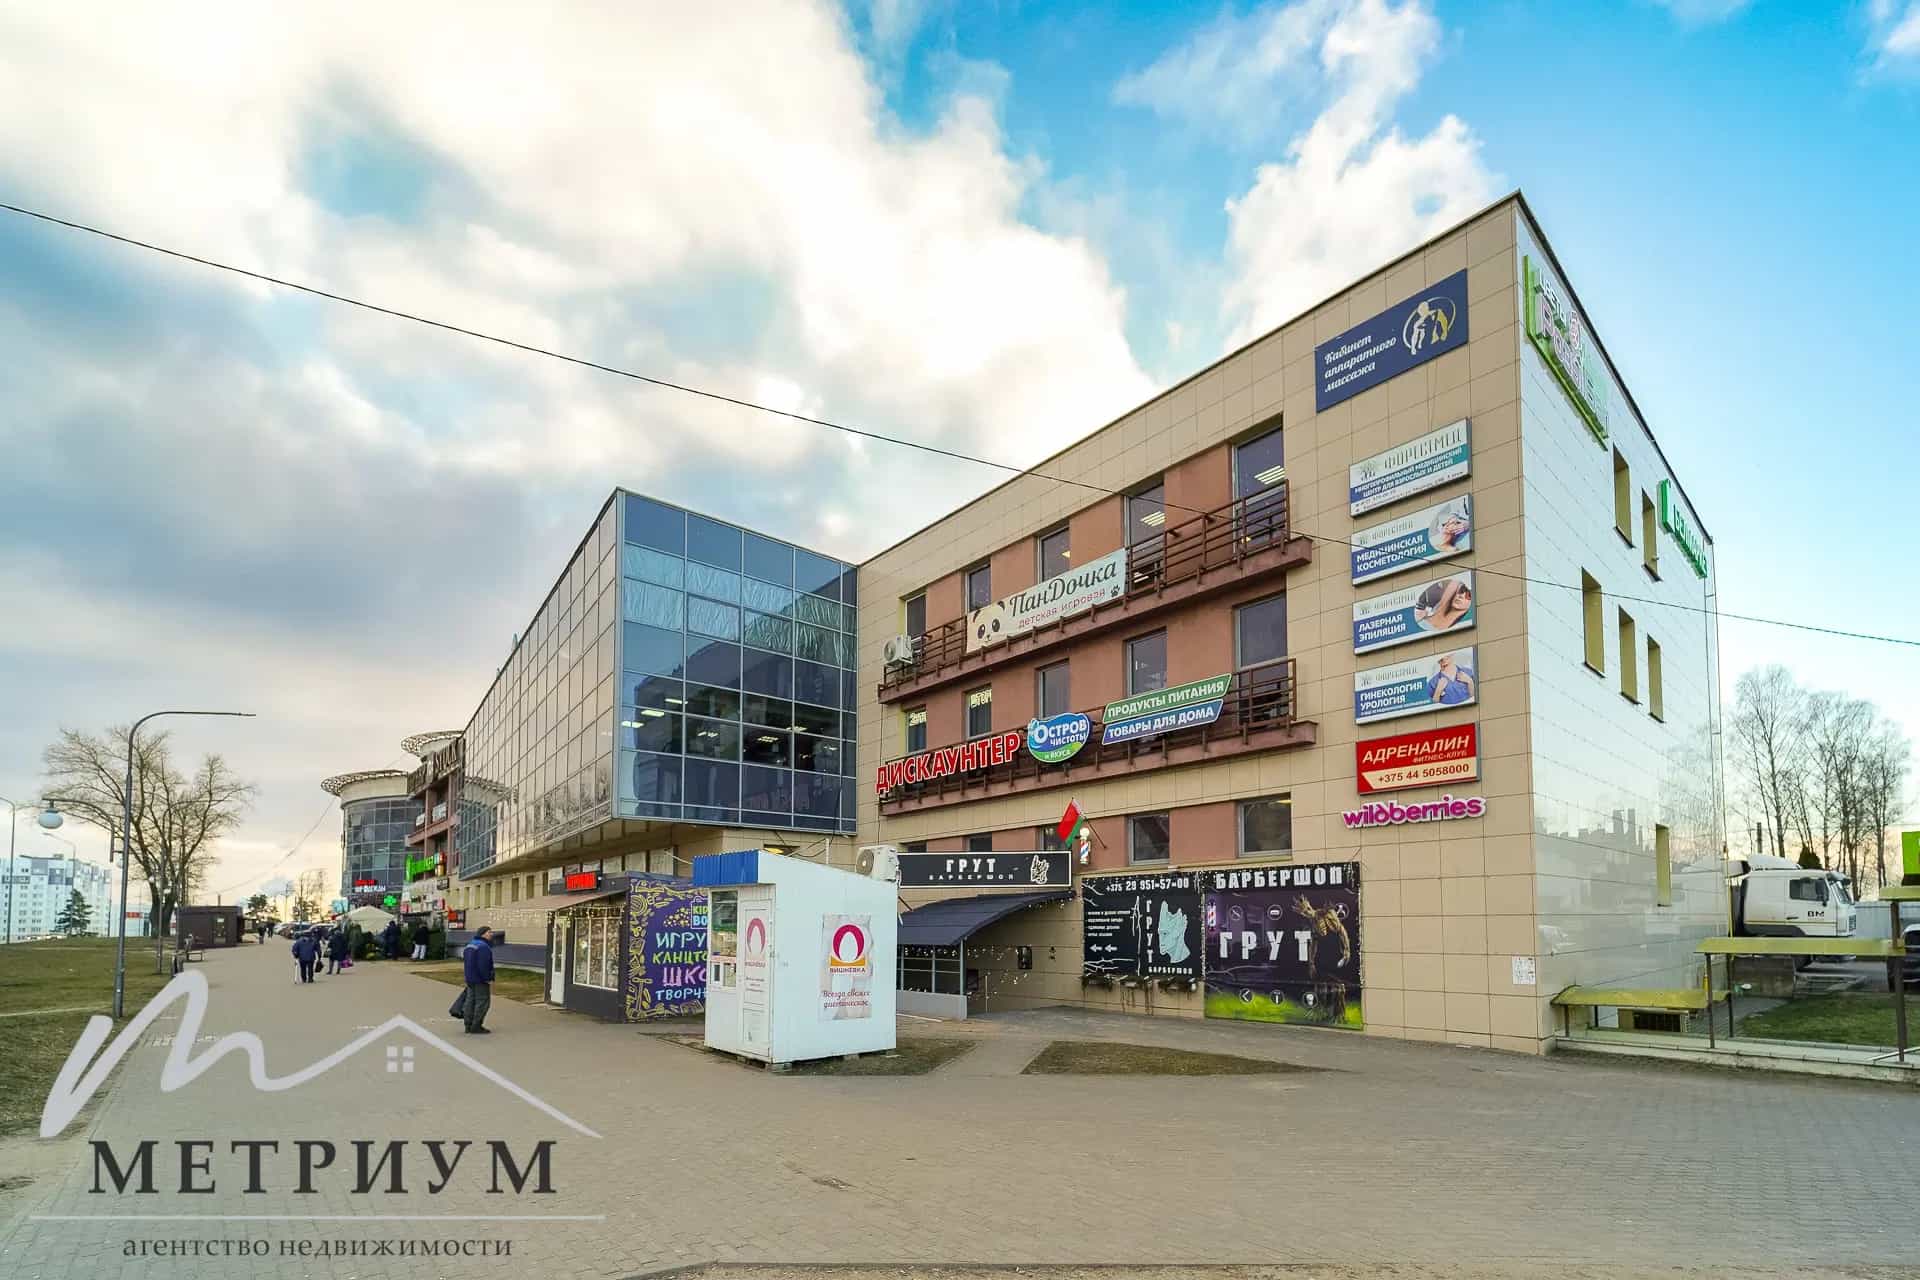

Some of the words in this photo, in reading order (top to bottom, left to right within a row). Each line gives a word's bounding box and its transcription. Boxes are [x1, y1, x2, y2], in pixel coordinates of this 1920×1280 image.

[1324, 336, 1372, 364] Кабинет
[1324, 337, 1397, 379] аппаратного
[1324, 361, 1376, 392] массажа
[1382, 482, 1395, 493] ДЛЯ
[1395, 470, 1427, 488] ВЗРОСЛЫХ
[1432, 459, 1454, 473] ДЕТЕЙ
[1356, 534, 1423, 563] МЕДИЦИНСКАЯ
[1357, 543, 1427, 572] КОСМЕТОЛОГИЯ
[1358, 613, 1403, 633] ЛАЗЕРНАЯ
[1359, 623, 1406, 642] ЭПИЛЯЦИЯ
[1107, 696, 1166, 718] ПРОДУКТЫ
[1167, 680, 1225, 704] ПИТАНИЯ
[1360, 681, 1422, 702] ГИНЕКОЛОГИЯ
[1360, 695, 1406, 712] УРОЛОГИЯ
[1108, 720, 1152, 738] ТОВАРЫ
[1152, 715, 1176, 731] ДЛЯ
[1177, 706, 1215, 725] ДОМА
[1050, 732, 1087, 747] ЧИСТОТЫ
[1361, 735, 1470, 765] АДРЕНАЛИН
[875, 732, 1020, 795] ДИСКАУНТЕР
[1413, 749, 1468, 763] ФИТНЕС-КЛУБ
[1377, 771, 1403, 783] +375
[1406, 770, 1419, 780] 44
[1422, 763, 1470, 777] 5058000
[1343, 796, 1483, 827] wildberries
[928, 873, 1015, 881] БАРБЕРШОП
[945, 857, 996, 873] ГРУТ
[1215, 865, 1343, 890] БАРБЕРШОП
[1105, 883, 1122, 892] +375
[655, 931, 706, 949] ИГРУ
[1219, 930, 1312, 962] ГРУТ
[1148, 966, 1193, 975] БАРБЕРШОП
